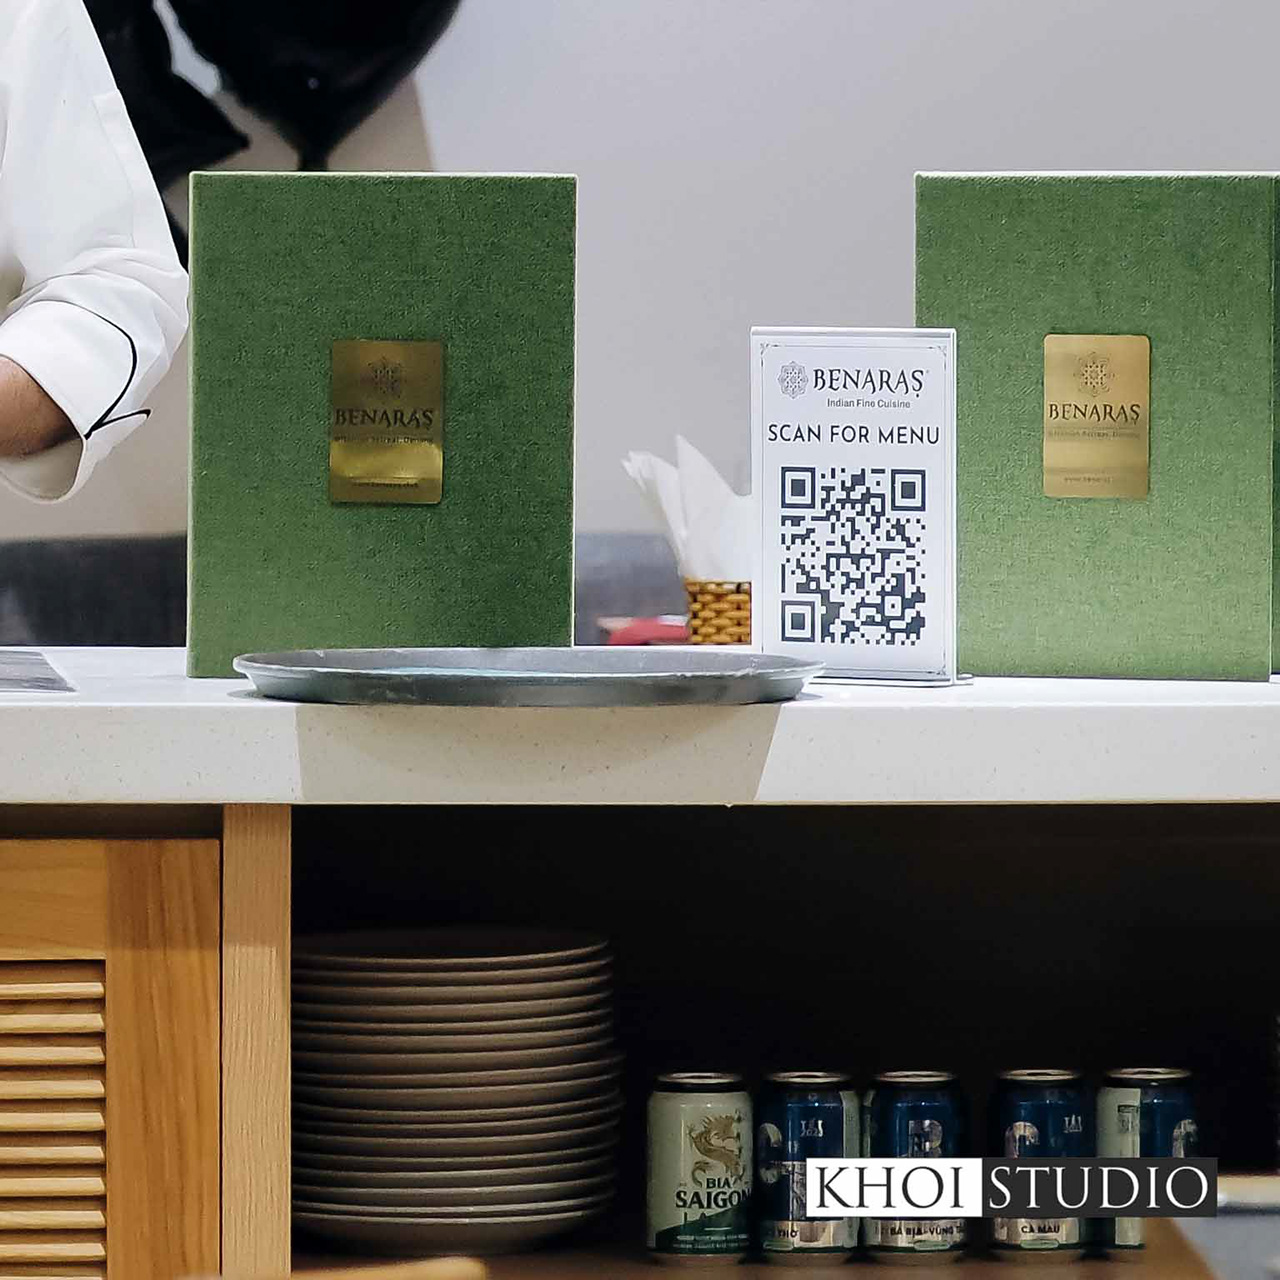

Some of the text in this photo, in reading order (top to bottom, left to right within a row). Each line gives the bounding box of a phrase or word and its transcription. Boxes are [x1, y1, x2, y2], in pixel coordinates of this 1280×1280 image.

[827, 397, 911, 409] Indian Fine Cuisine
[768, 424, 940, 444] SCAN FOR MENU
[706, 1178, 732, 1189] BIA
[676, 1190, 752, 1209] SAIGON
